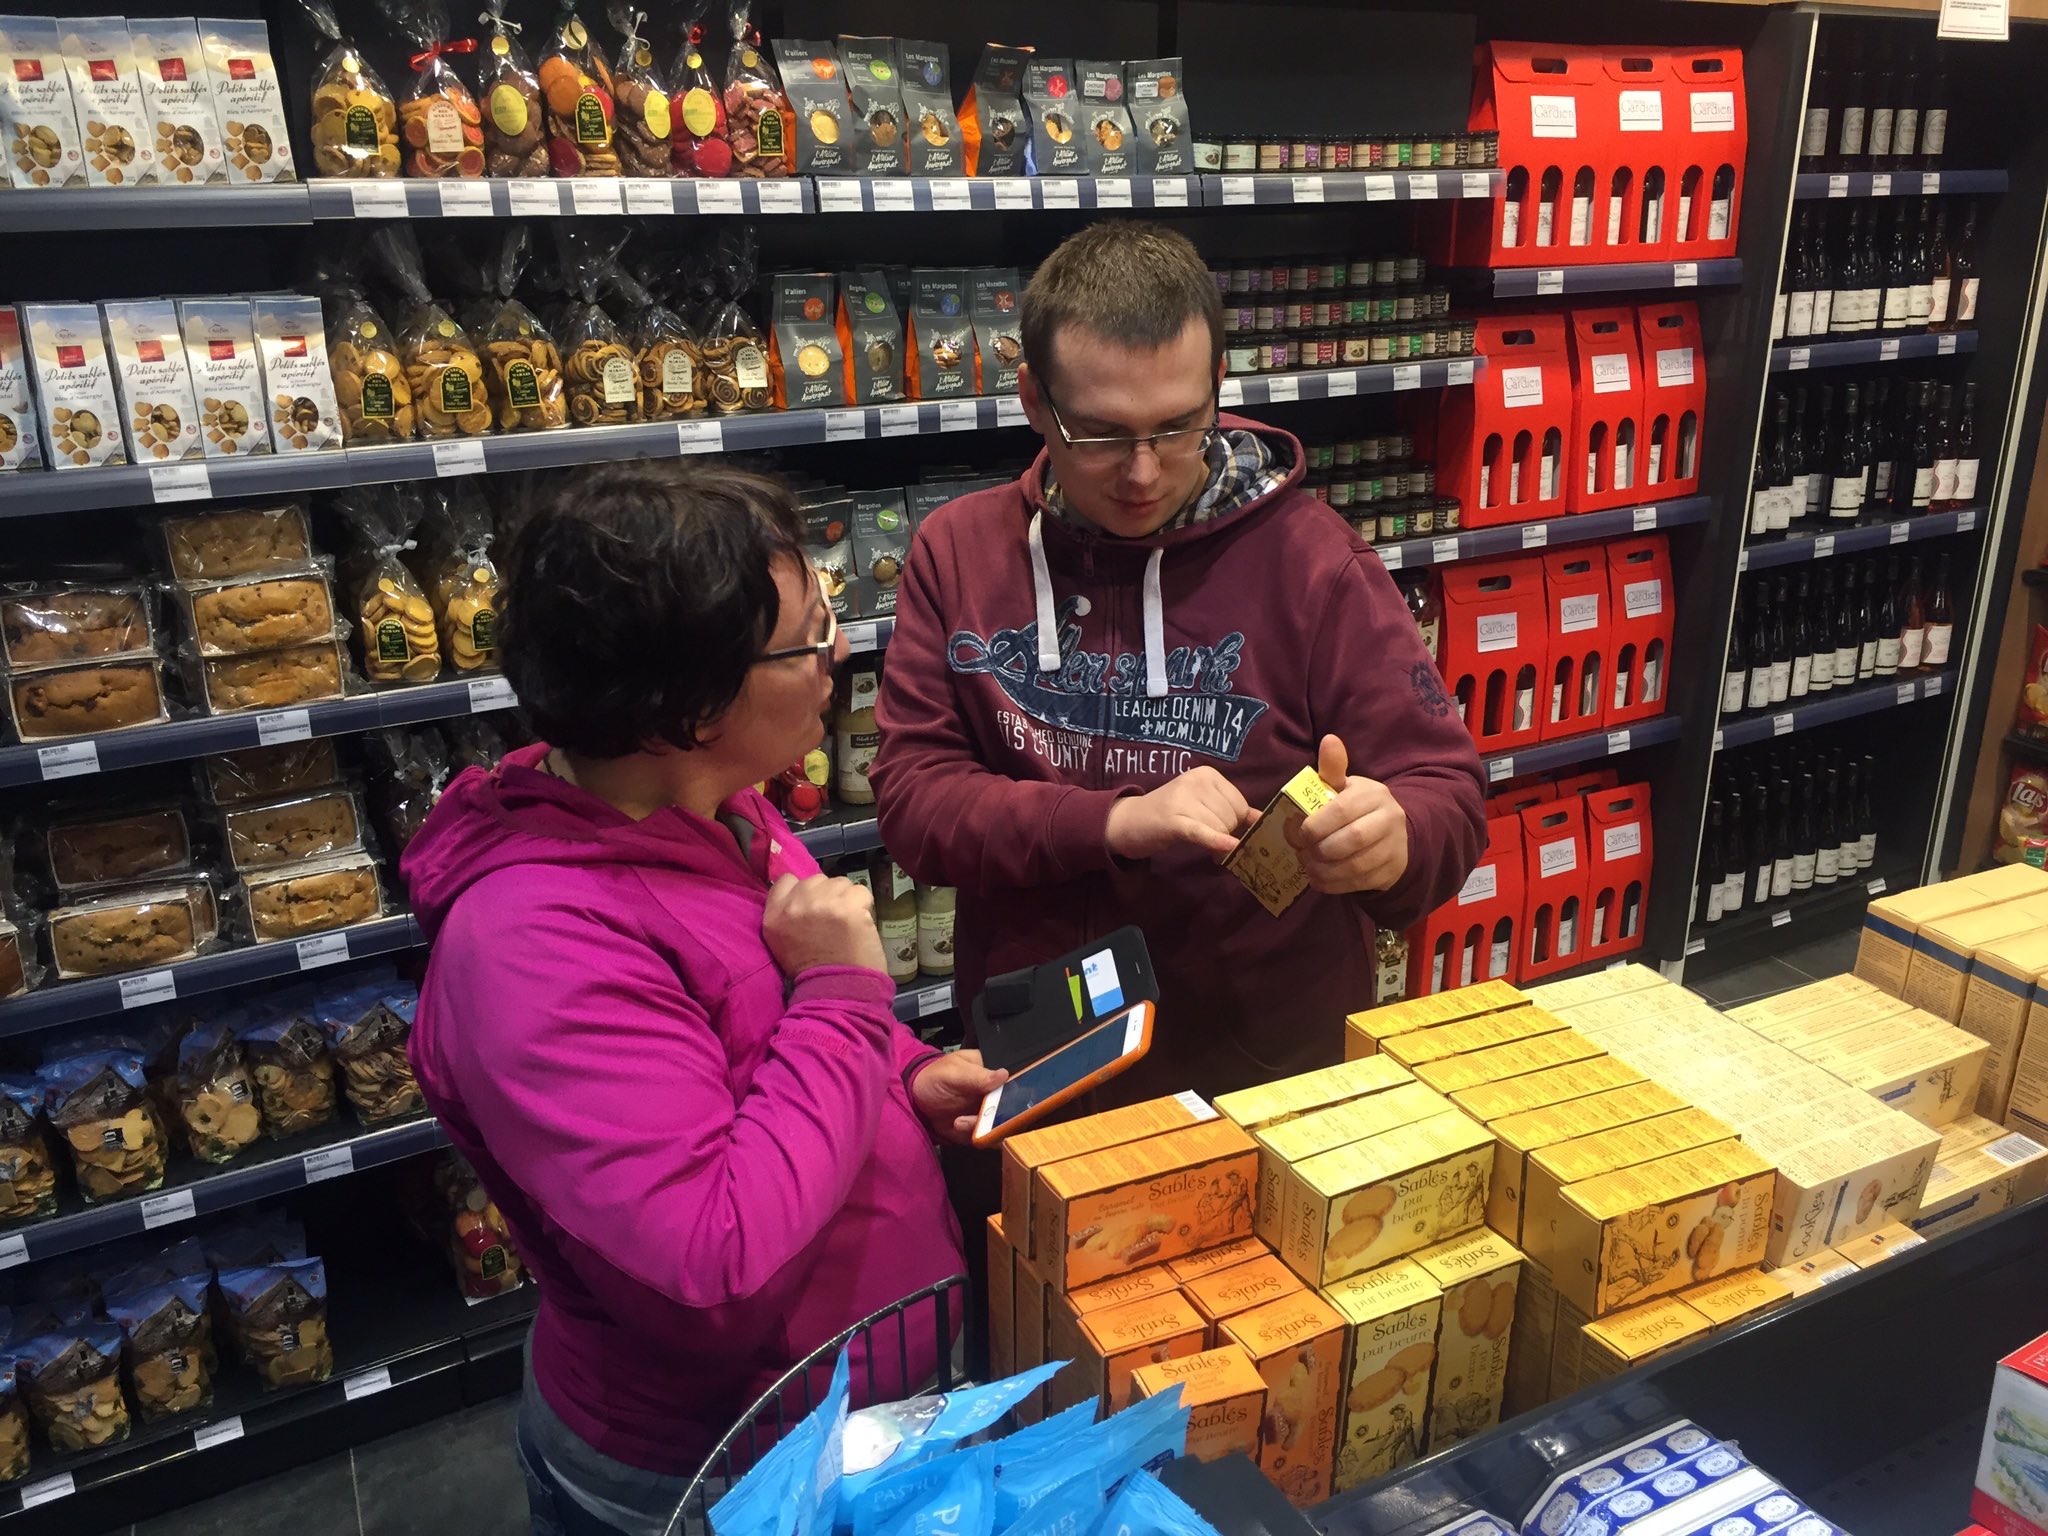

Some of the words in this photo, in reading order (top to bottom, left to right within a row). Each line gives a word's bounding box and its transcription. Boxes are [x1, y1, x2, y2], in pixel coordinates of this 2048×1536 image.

[1115, 700, 1168, 718] LEAGUE
[1172, 697, 1217, 725] DENIM
[1224, 702, 1244, 736] 74
[1057, 731, 1093, 749] GENUINE
[1154, 721, 1232, 753] MCMLXXIV
[1105, 748, 1192, 775] ATHLETIC
[1149, 1173, 1207, 1201] Sablés
[1397, 1168, 1449, 1197] Sablés
[1263, 1167, 1281, 1231] Sablés
[1402, 1194, 1424, 1211] pur
[1391, 1204, 1433, 1225] beurre
[1746, 1191, 1770, 1253] Sablés
[1792, 1189, 1825, 1258] Cookies
[1298, 1202, 1317, 1261] Sablés
[1185, 1241, 1247, 1267] Sablés
[1439, 1244, 1500, 1270] Sablés
[1089, 1276, 1155, 1302] Sablés
[1218, 1276, 1282, 1302] Sablés
[1347, 1271, 1409, 1296] Sablés
[1353, 1294, 1378, 1312] pur
[1381, 1278, 1426, 1301] beurre
[1707, 1282, 1767, 1308] Sablés
[1113, 1313, 1181, 1338] Sablés
[1258, 1313, 1323, 1341] Sablés
[1373, 1311, 1428, 1341] Sablés
[1622, 1313, 1685, 1342] Sablés
[1361, 1343, 1386, 1361] pur
[1389, 1328, 1432, 1350] beurre
[1160, 1353, 1232, 1380] Sablés
[1485, 1336, 1507, 1393] Sablés
[1186, 1405, 1249, 1432] Sablés
[1313, 1406, 1335, 1465] Sablés
